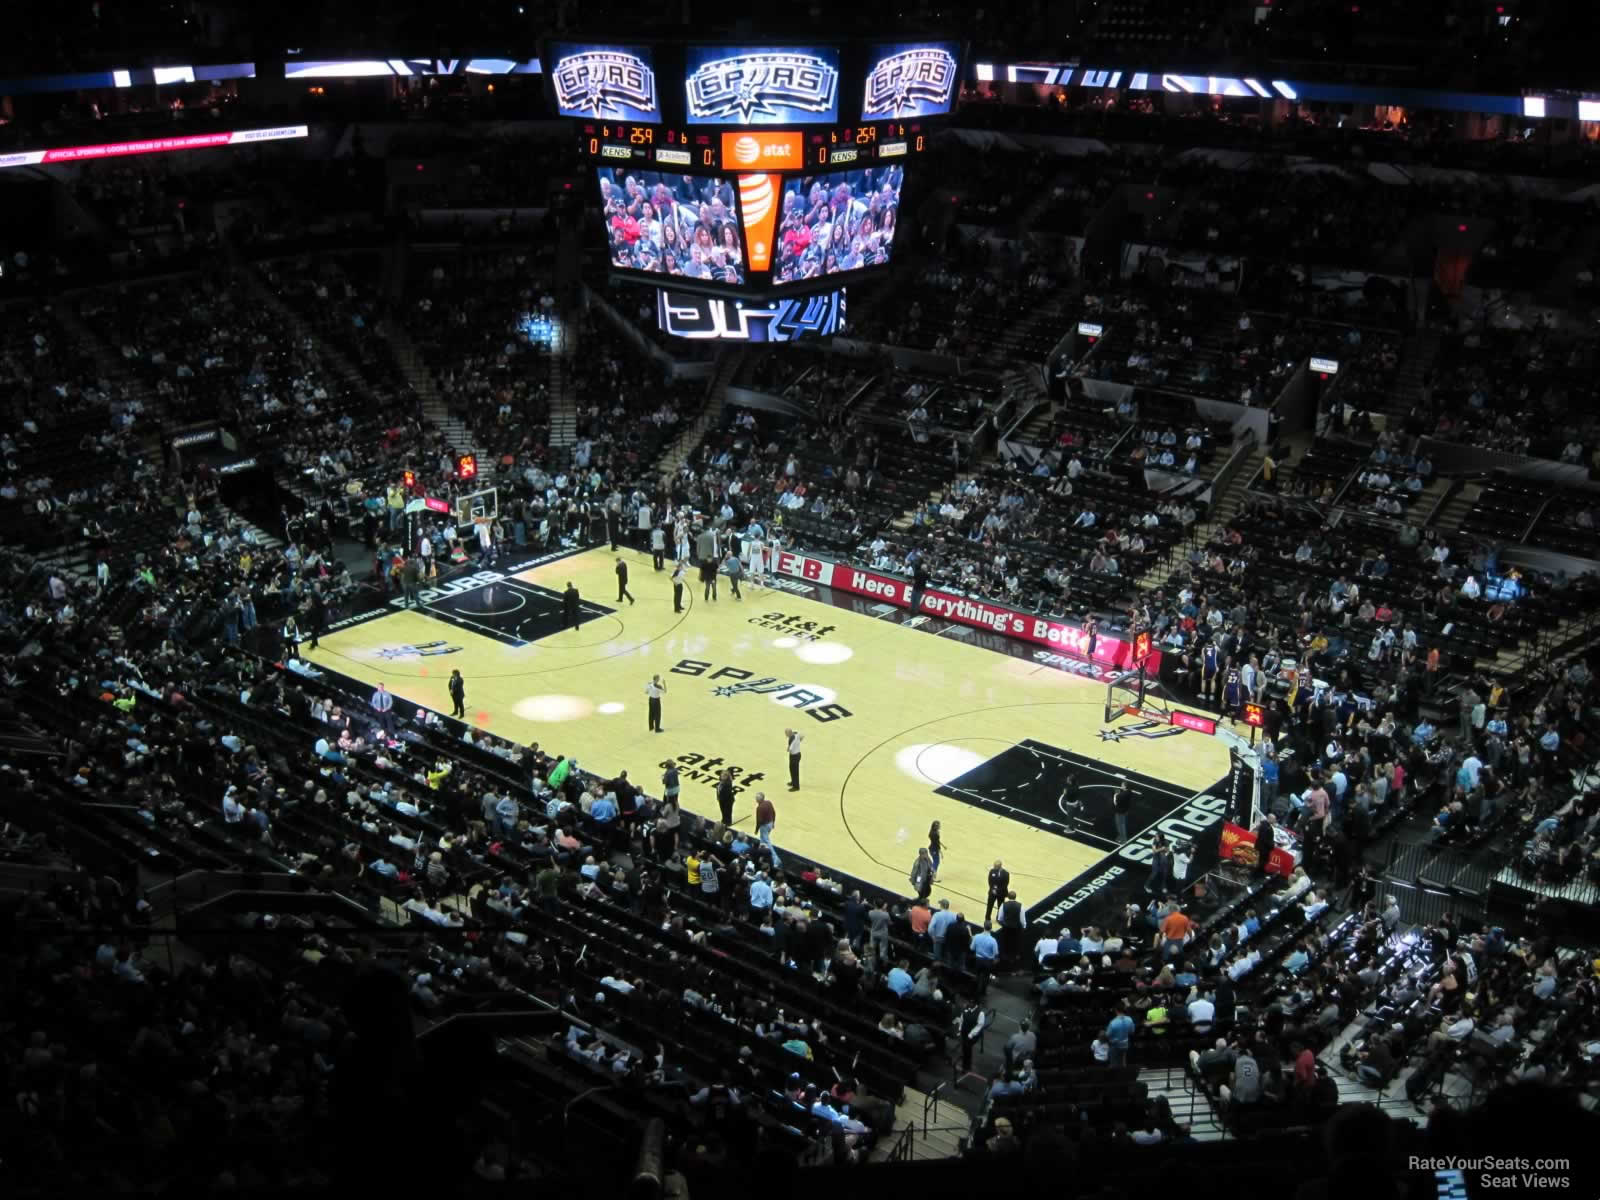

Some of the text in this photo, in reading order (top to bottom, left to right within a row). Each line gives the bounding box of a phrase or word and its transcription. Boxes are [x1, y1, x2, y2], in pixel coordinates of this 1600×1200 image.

[562, 64, 642, 92] SPURS
[700, 66, 822, 97] SPURS
[876, 62, 947, 94] SPURS
[590, 139, 598, 154] 0
[704, 149, 711, 165] 0
[763, 143, 792, 157] at&t
[820, 148, 827, 163] 0
[852, 571, 896, 597] Here
[748, 617, 822, 642] CENTER
[763, 611, 836, 636] at&t
[670, 660, 853, 723] SPURS
[1032, 866, 1125, 925] BASKETBALL
